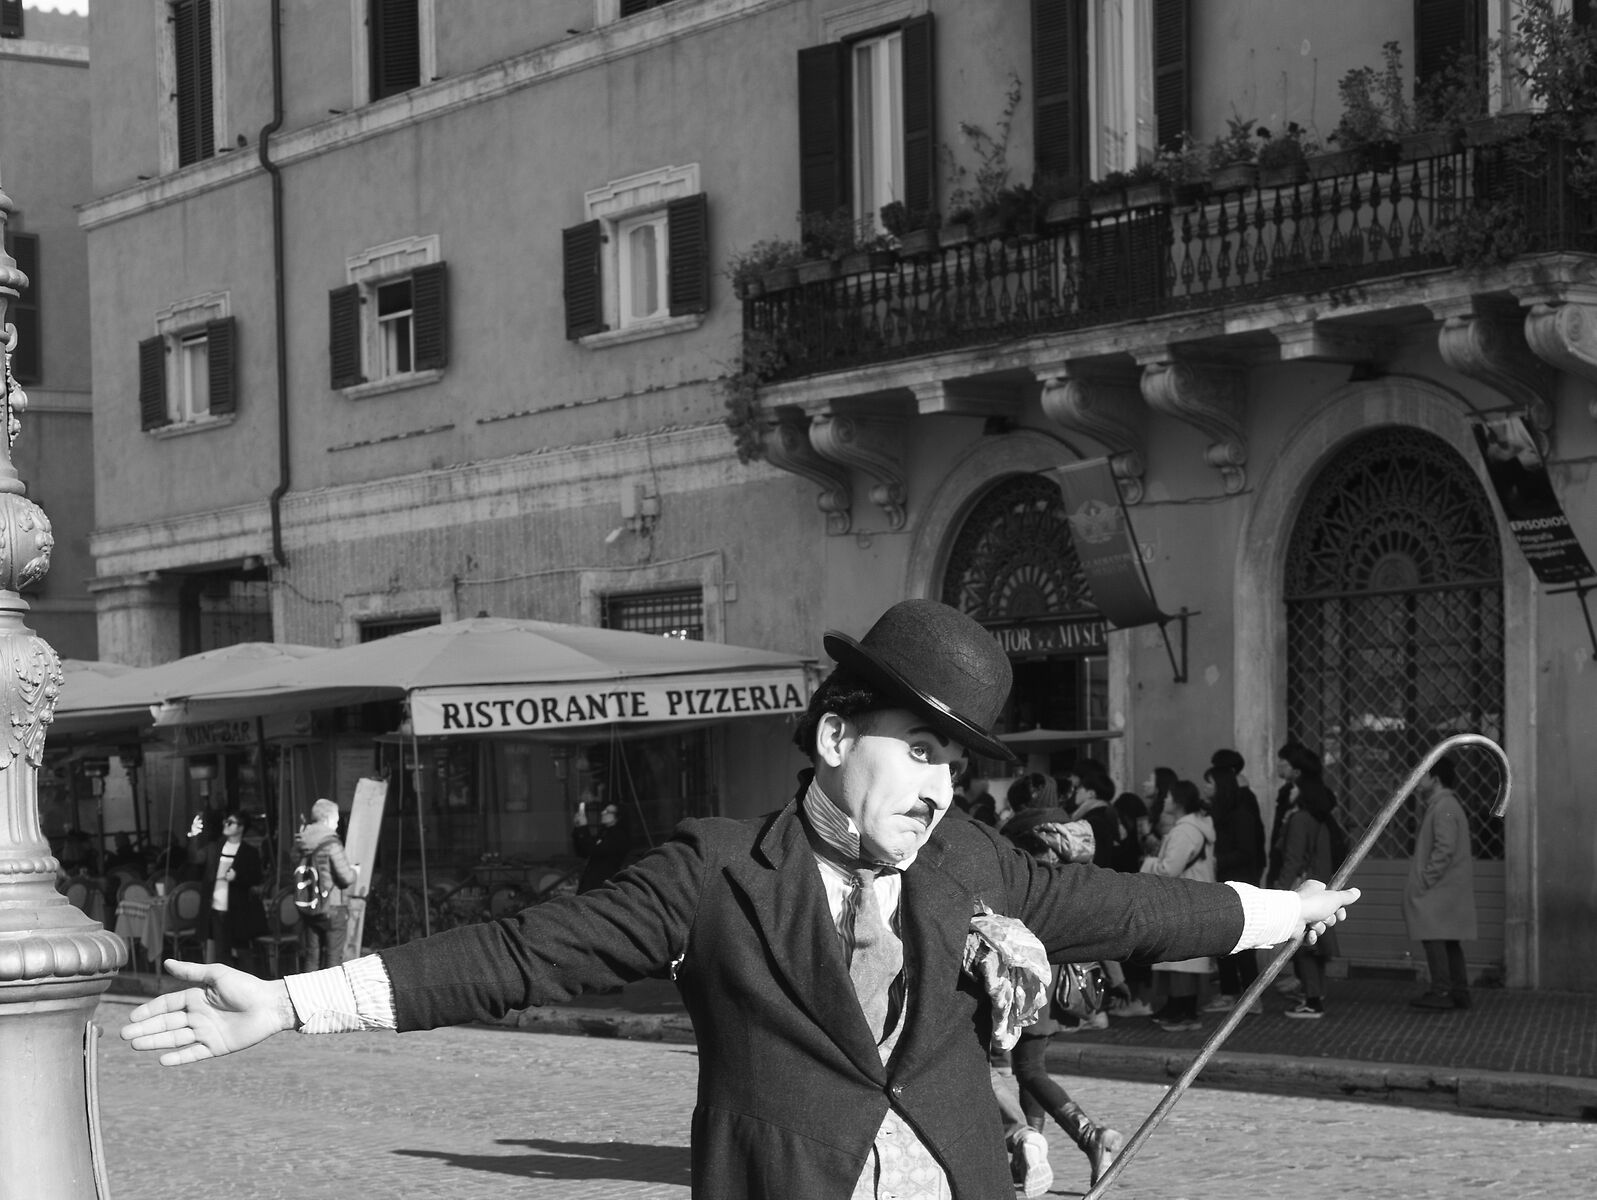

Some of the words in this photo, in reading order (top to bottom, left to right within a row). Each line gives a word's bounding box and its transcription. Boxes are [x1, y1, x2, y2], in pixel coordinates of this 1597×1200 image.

[1510, 516, 1568, 531] EPISODIOS
[441, 691, 649, 729] RISTORANTE
[666, 683, 804, 716] PIZZERIA
[222, 721, 251, 742] BAR
